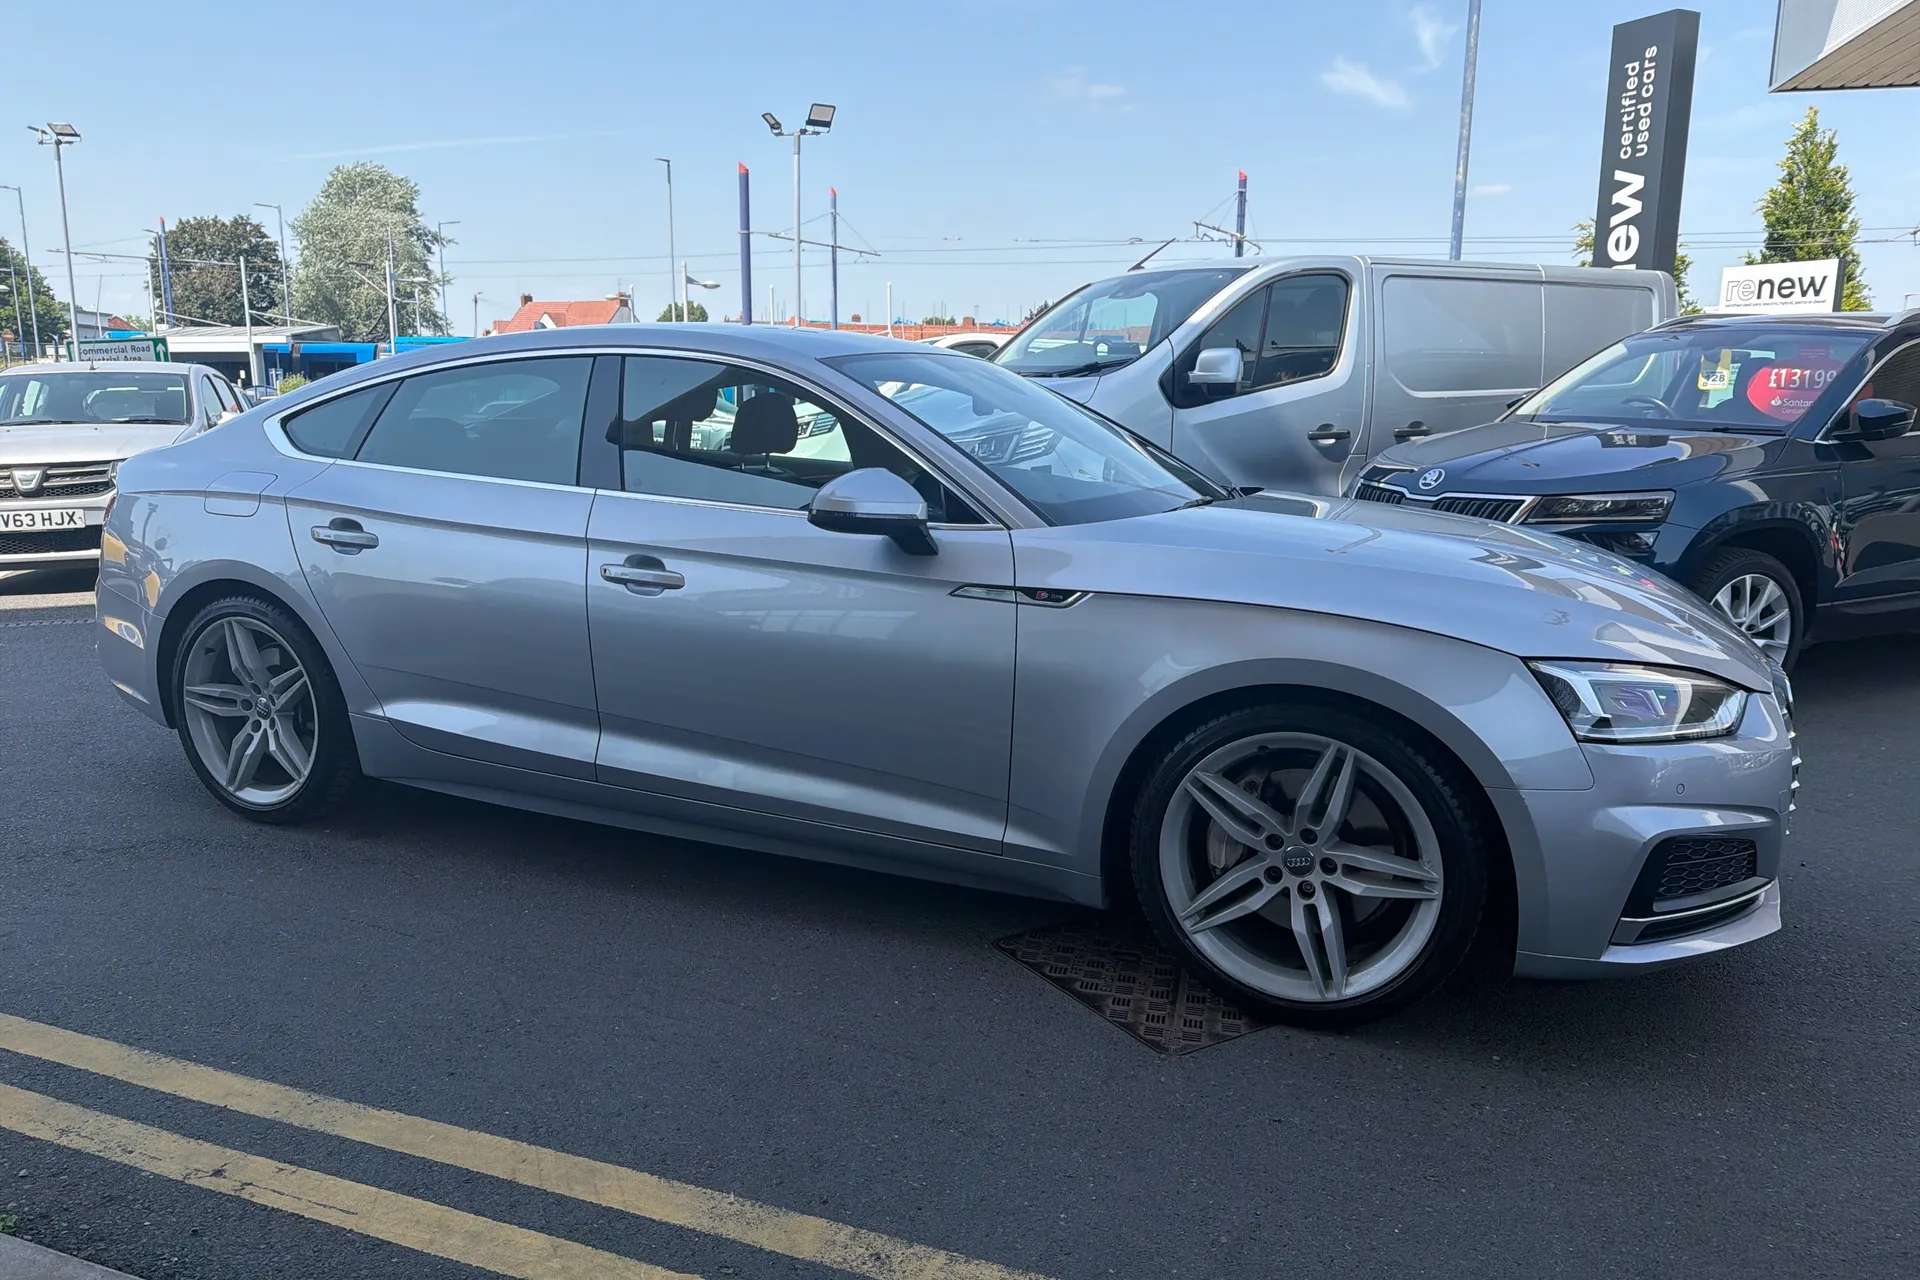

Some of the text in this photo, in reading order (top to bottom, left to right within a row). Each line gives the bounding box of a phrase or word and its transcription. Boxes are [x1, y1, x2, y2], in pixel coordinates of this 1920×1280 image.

[1620, 61, 1640, 159] certified
[1635, 45, 1658, 157] used cars
[1607, 169, 1645, 270] ew
[1726, 275, 1828, 301] renew
[131, 344, 151, 353] Road
[41, 511, 77, 526] HJX
